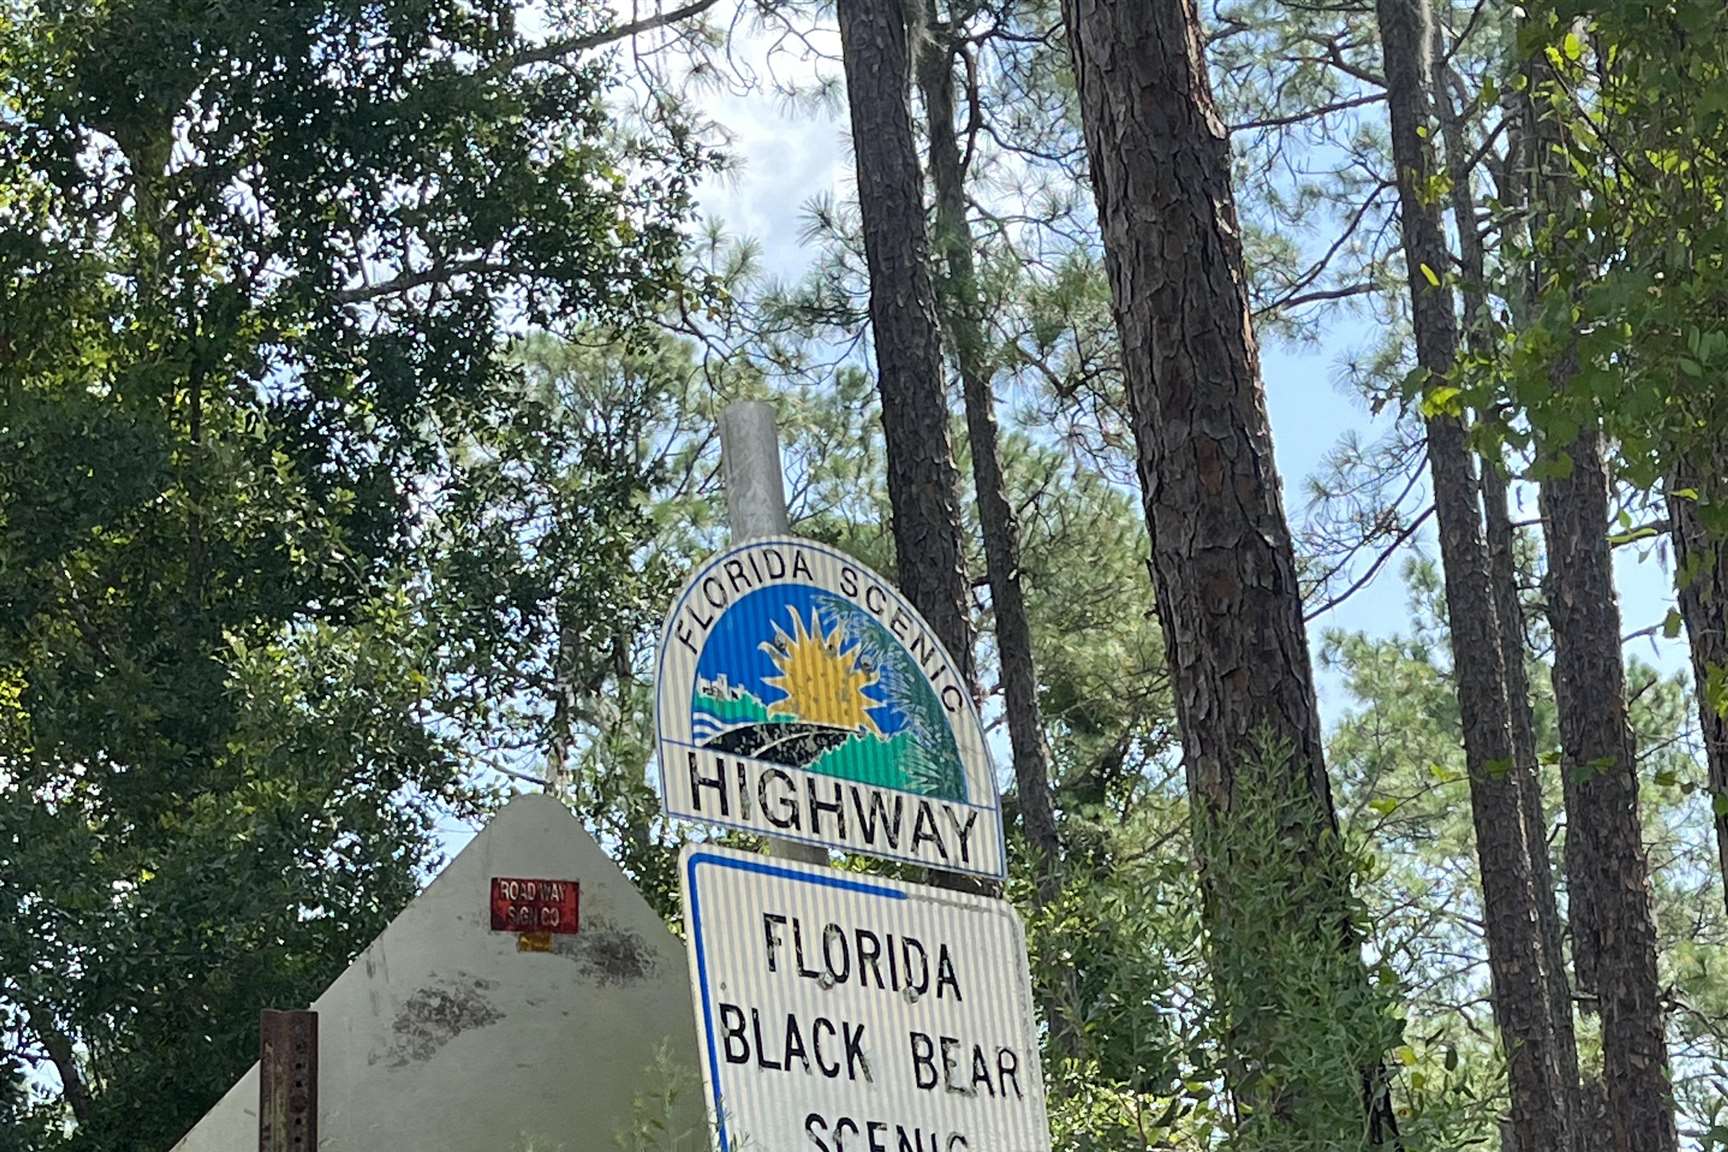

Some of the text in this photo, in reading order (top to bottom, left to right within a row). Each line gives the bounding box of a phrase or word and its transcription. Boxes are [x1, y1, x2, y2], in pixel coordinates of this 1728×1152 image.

[677, 549, 962, 714] FLORIDA SCENIC
[688, 751, 978, 864] HIGHWAY
[762, 912, 963, 1002] FLORIDA
[719, 1002, 1023, 1100] BLACK BEAR
